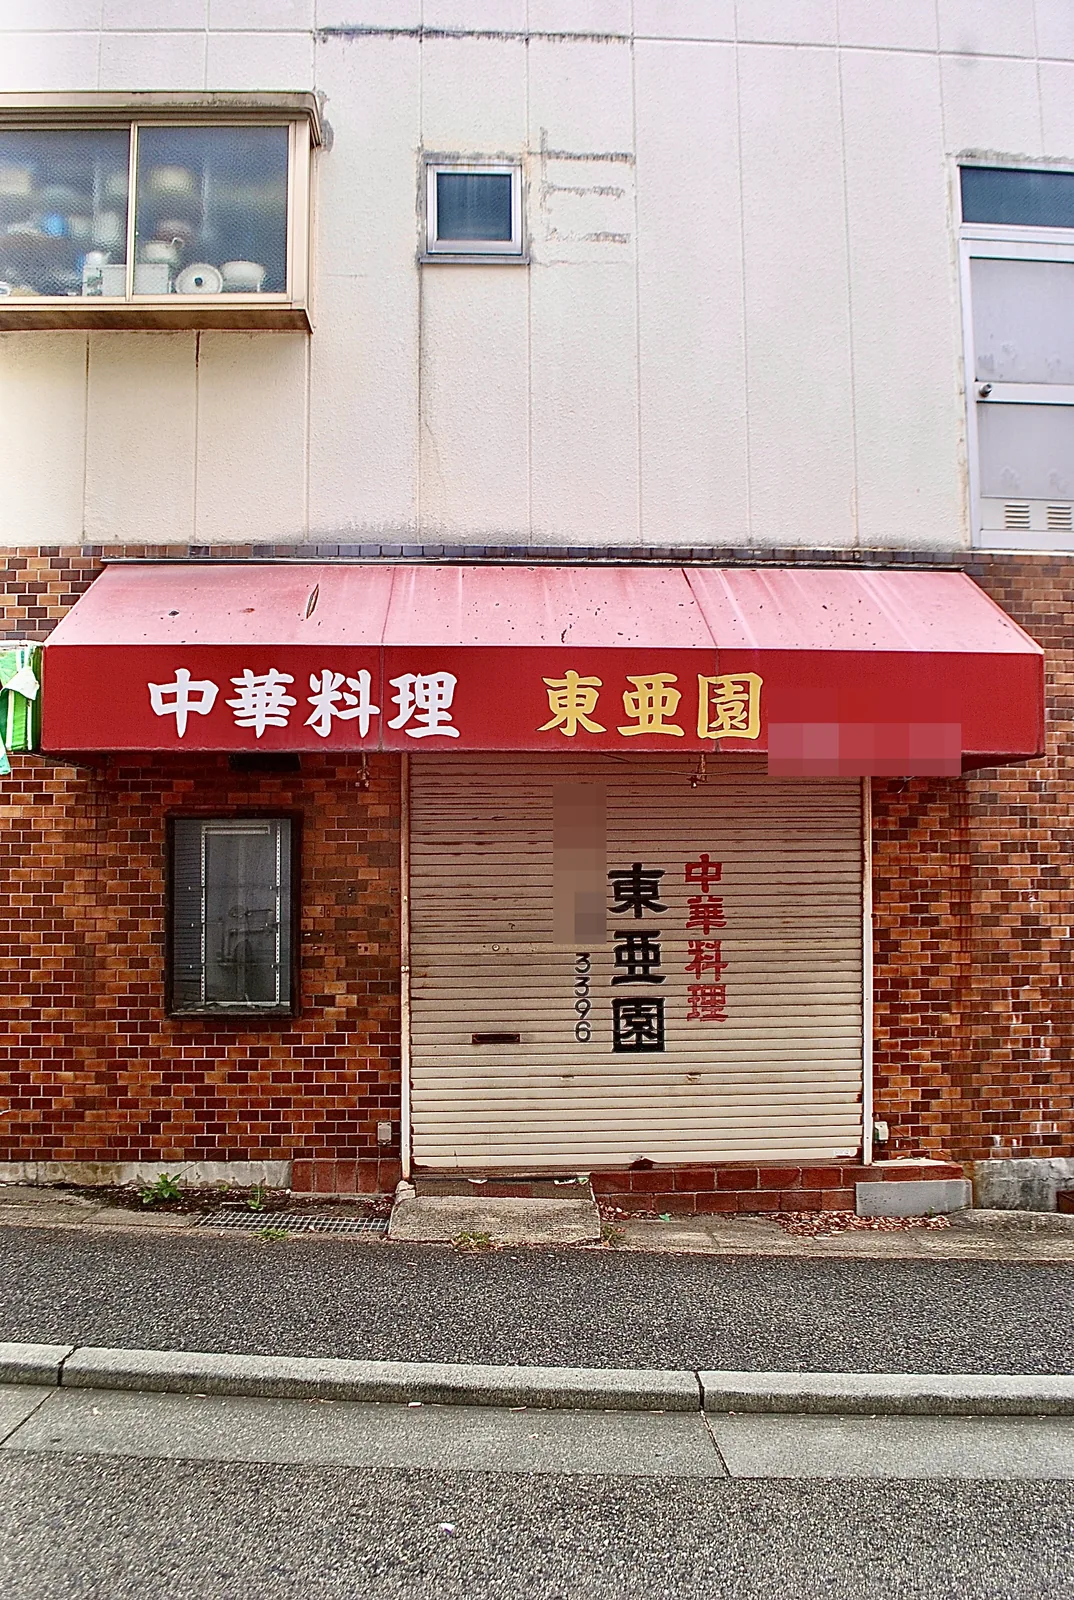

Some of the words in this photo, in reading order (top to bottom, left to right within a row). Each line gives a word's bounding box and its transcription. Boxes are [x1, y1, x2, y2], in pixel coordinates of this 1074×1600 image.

[147, 668, 460, 739] 中華料理
[536, 669, 765, 740] 東亜園
[606, 862, 669, 1053] 東亜園
[684, 853, 729, 1023] 中華料理
